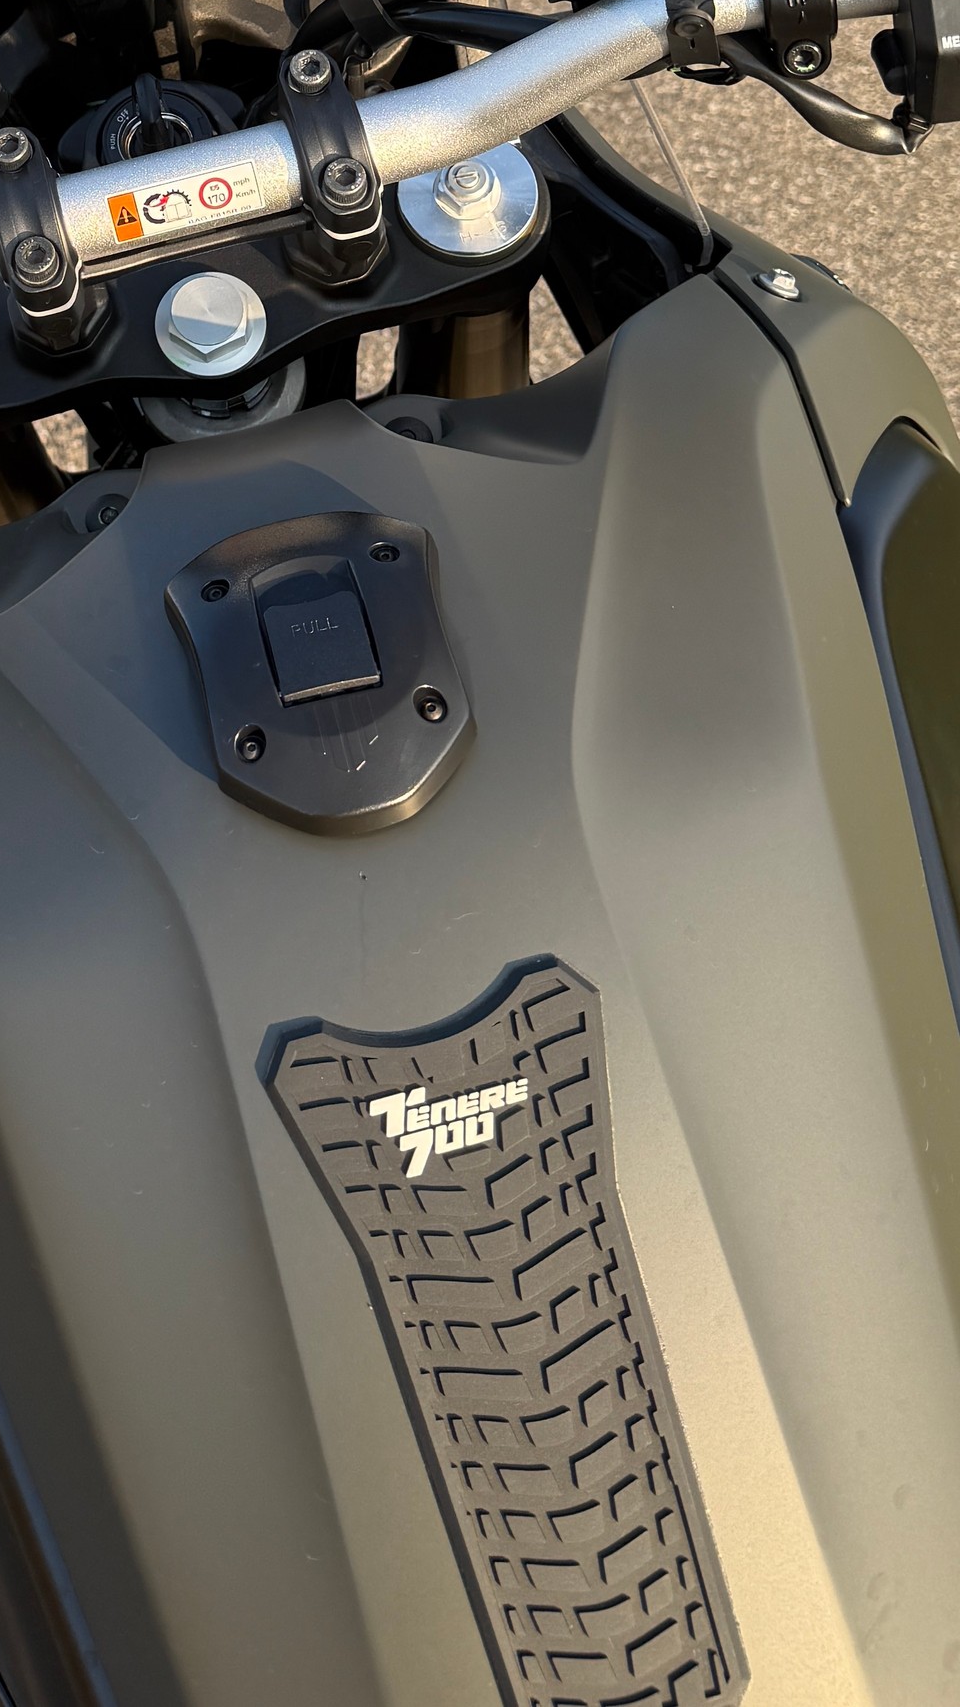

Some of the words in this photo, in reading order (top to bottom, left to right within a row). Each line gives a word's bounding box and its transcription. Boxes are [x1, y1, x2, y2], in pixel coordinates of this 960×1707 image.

[117, 108, 129, 123] OFF
[232, 177, 250, 188] mph
[207, 192, 226, 205] 170
[290, 617, 339, 638] PULL
[399, 1111, 495, 1179] 700
